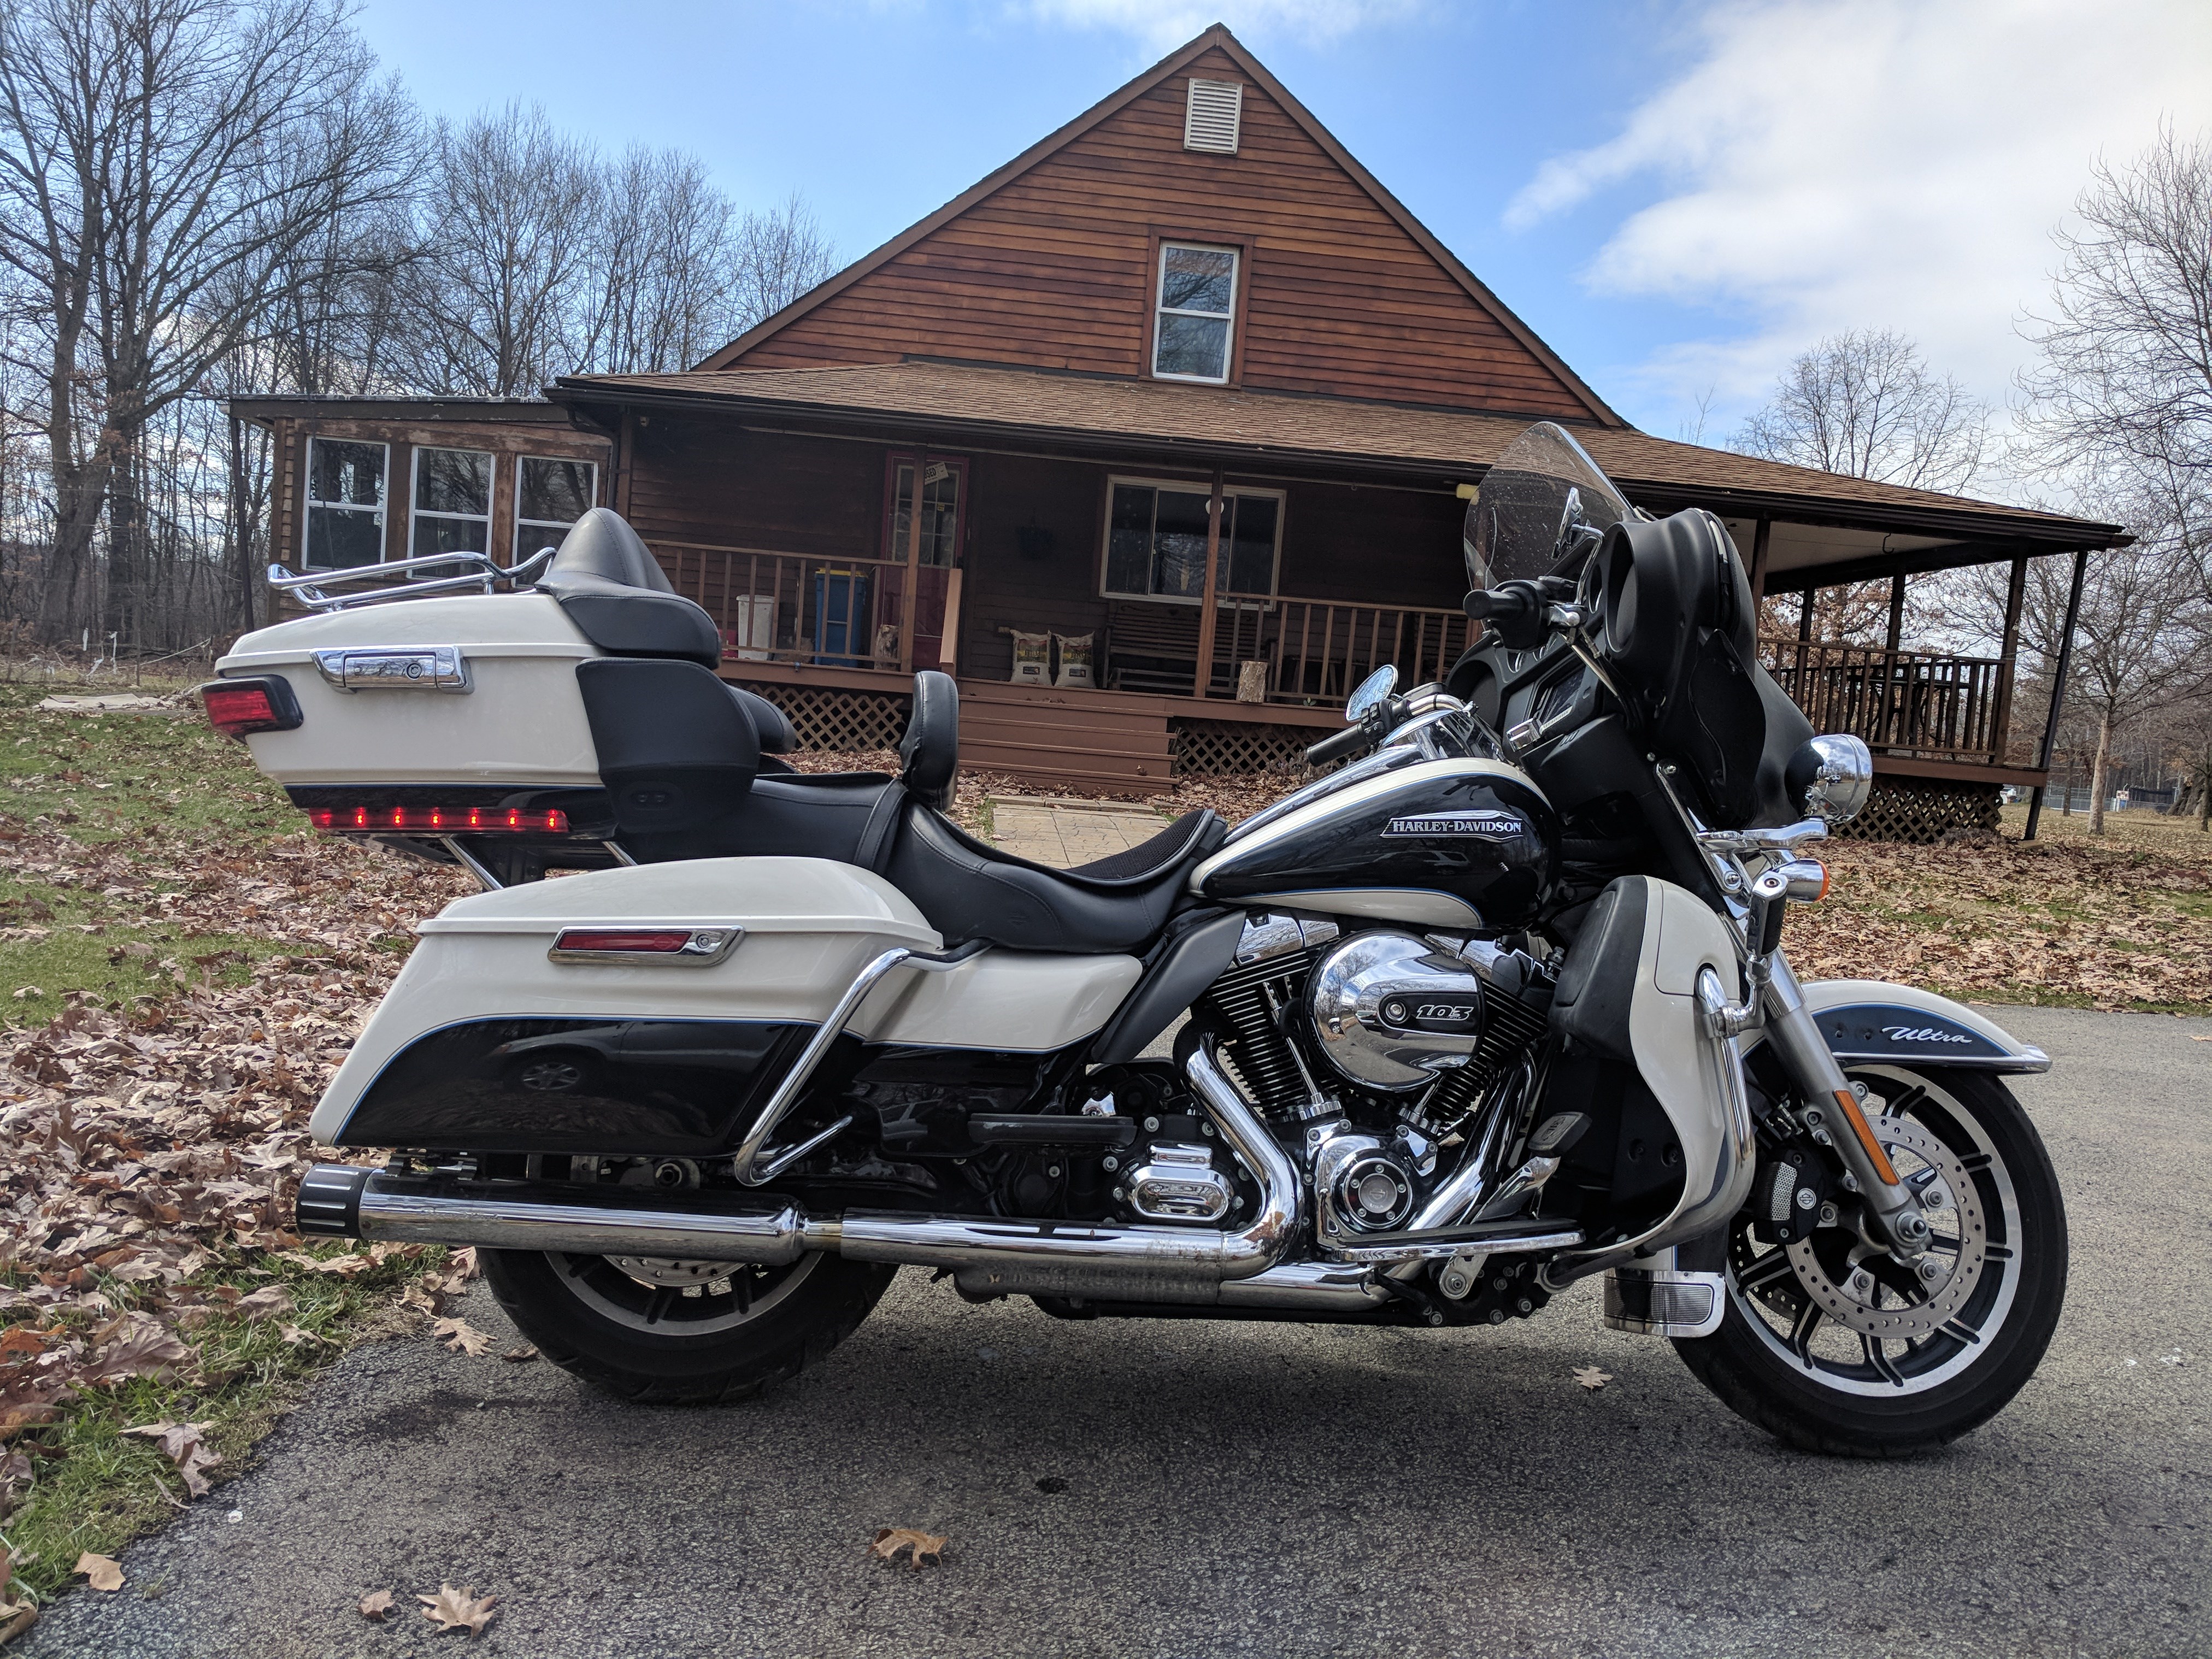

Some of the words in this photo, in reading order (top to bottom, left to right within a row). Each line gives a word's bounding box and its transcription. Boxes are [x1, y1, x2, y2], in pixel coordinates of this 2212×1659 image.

[1393, 821, 1521, 833] HARLEY-DAVIDSON
[1416, 1004, 1474, 1021] 103
[1881, 1026, 1973, 1044] Ultra
